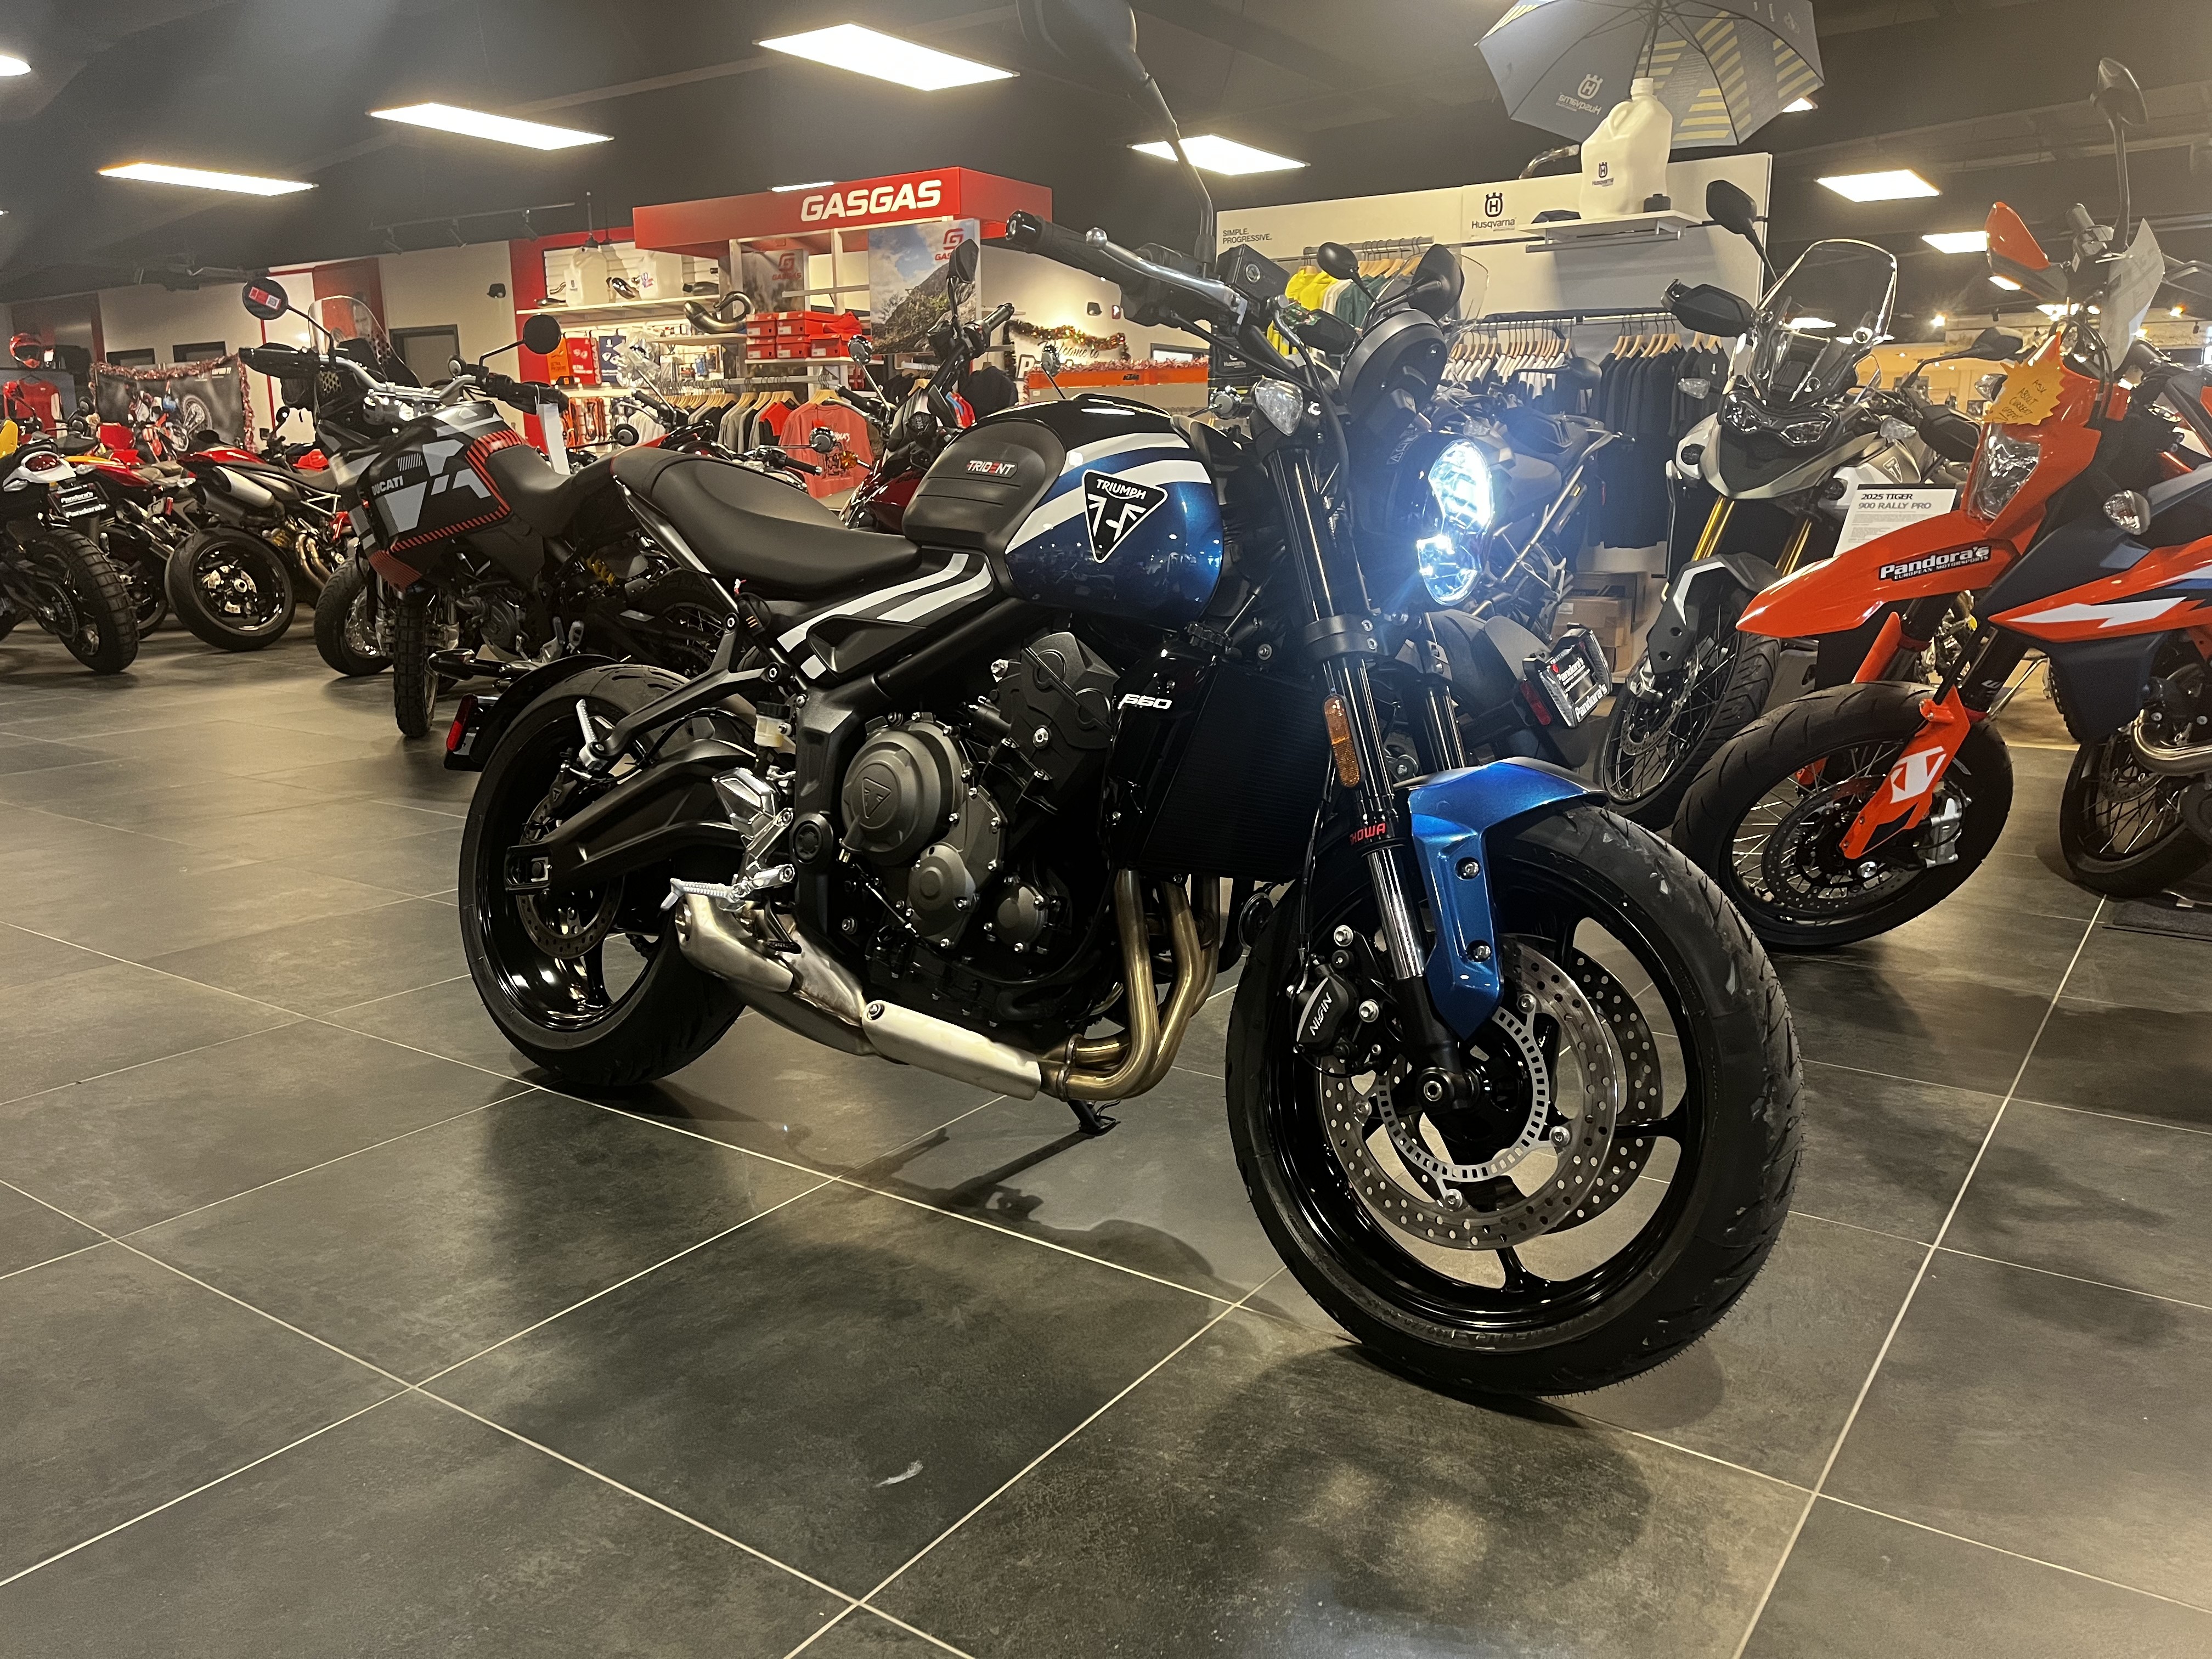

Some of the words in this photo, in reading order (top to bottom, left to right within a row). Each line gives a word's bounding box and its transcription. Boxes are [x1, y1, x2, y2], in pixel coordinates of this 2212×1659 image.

[800, 179, 942, 222] GASGAS
[1471, 218, 1515, 229] Husqvarna
[934, 252, 951, 261] GAS
[1037, 341, 1088, 358] lcome
[967, 460, 1015, 475] TRIDENT
[1096, 478, 1147, 500] TRIUMPH
[1881, 546, 1989, 579] Pandora's
[1894, 568, 1933, 580] EUROPEAN
[1936, 556, 1989, 570] MOTORSPORTS
[1118, 693, 1172, 710] 660
[1575, 684, 1608, 722] Pandora's
[1310, 992, 1332, 1036] NISSIN
